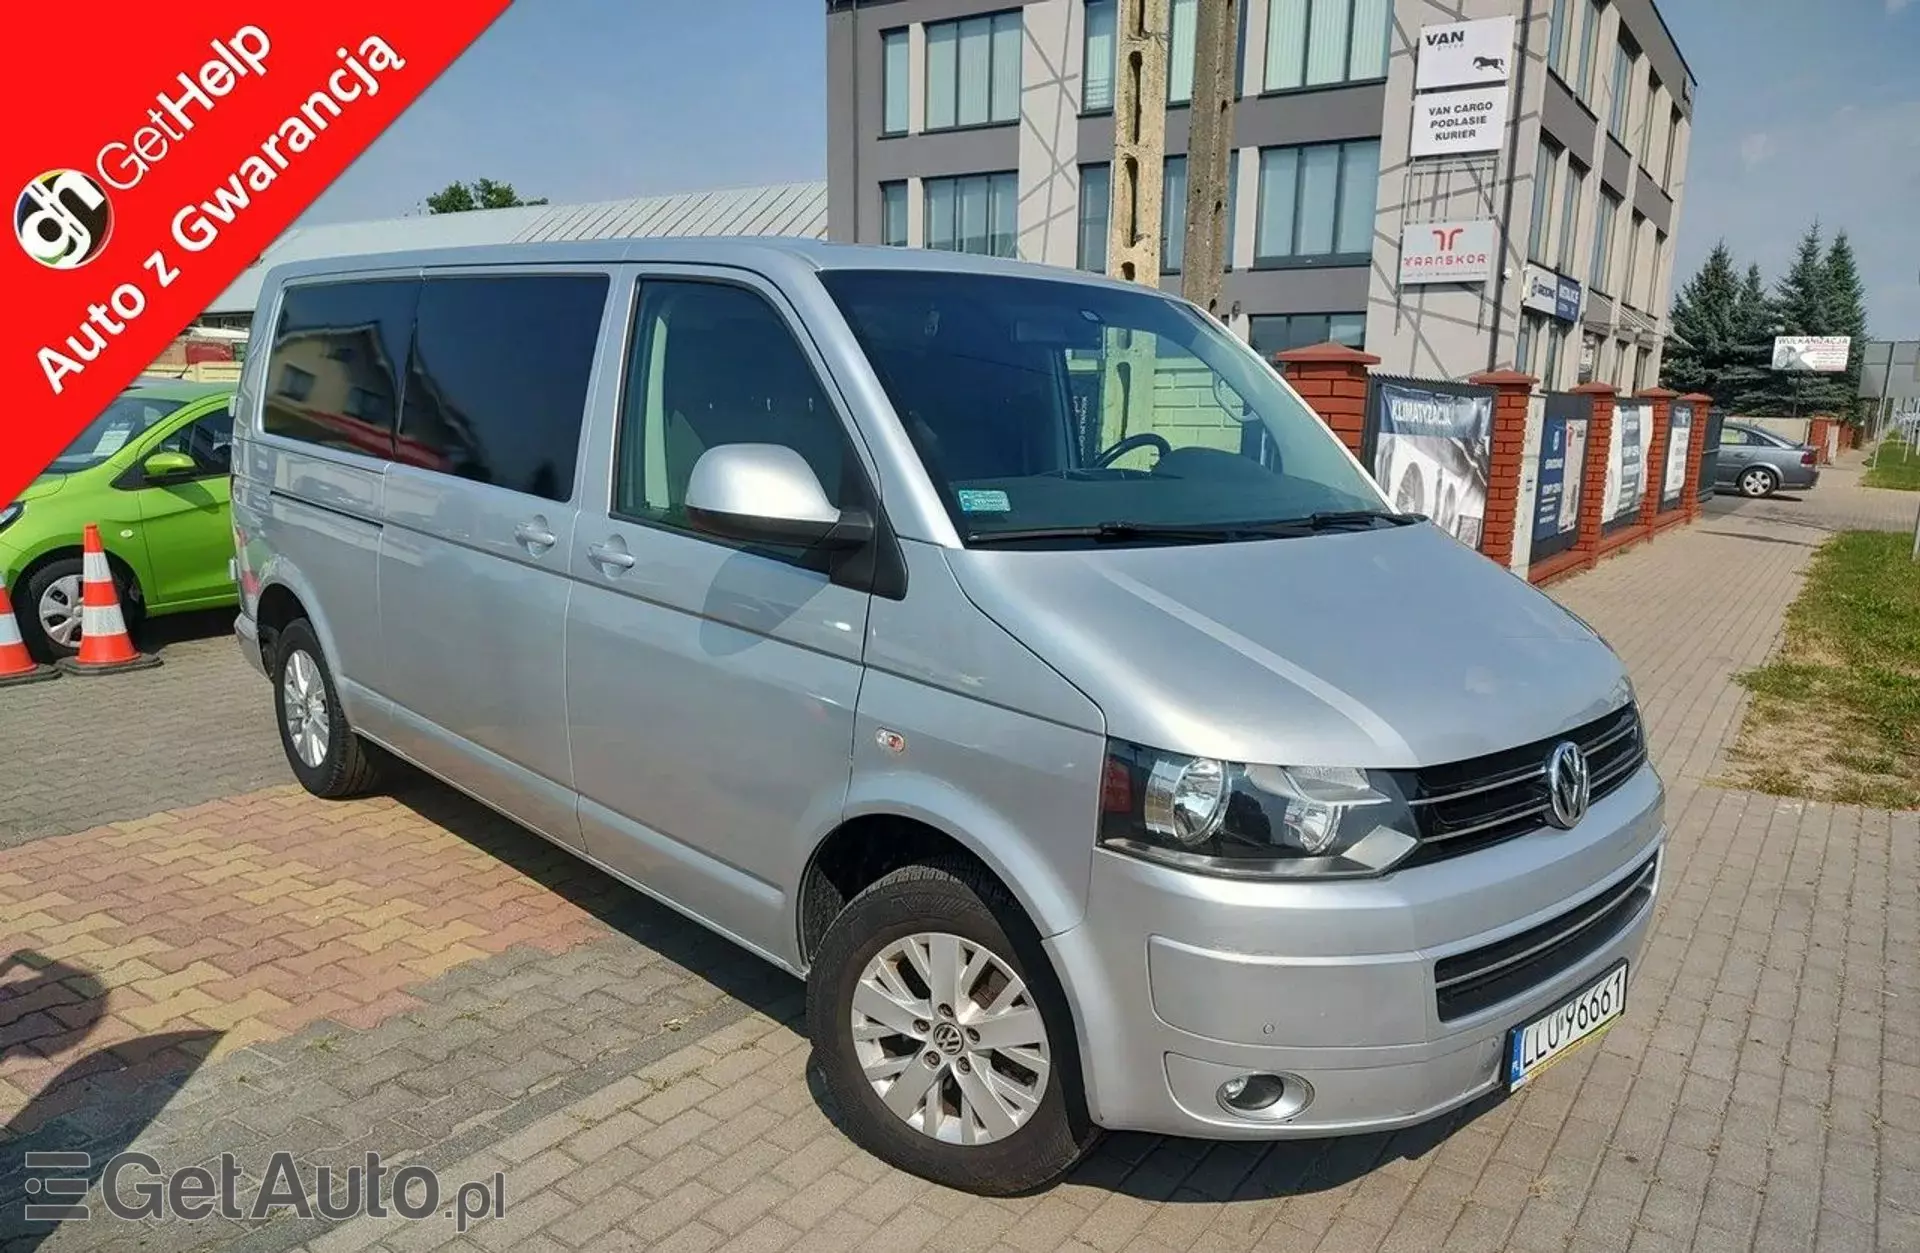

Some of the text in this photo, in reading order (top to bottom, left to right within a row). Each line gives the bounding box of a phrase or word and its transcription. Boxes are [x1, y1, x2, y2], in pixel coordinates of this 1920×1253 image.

[1426, 30, 1465, 46] VAN
[1428, 101, 1493, 116] VAN CARGO
[1430, 115, 1487, 128] PODLASIE
[1435, 129, 1476, 141] KURIER
